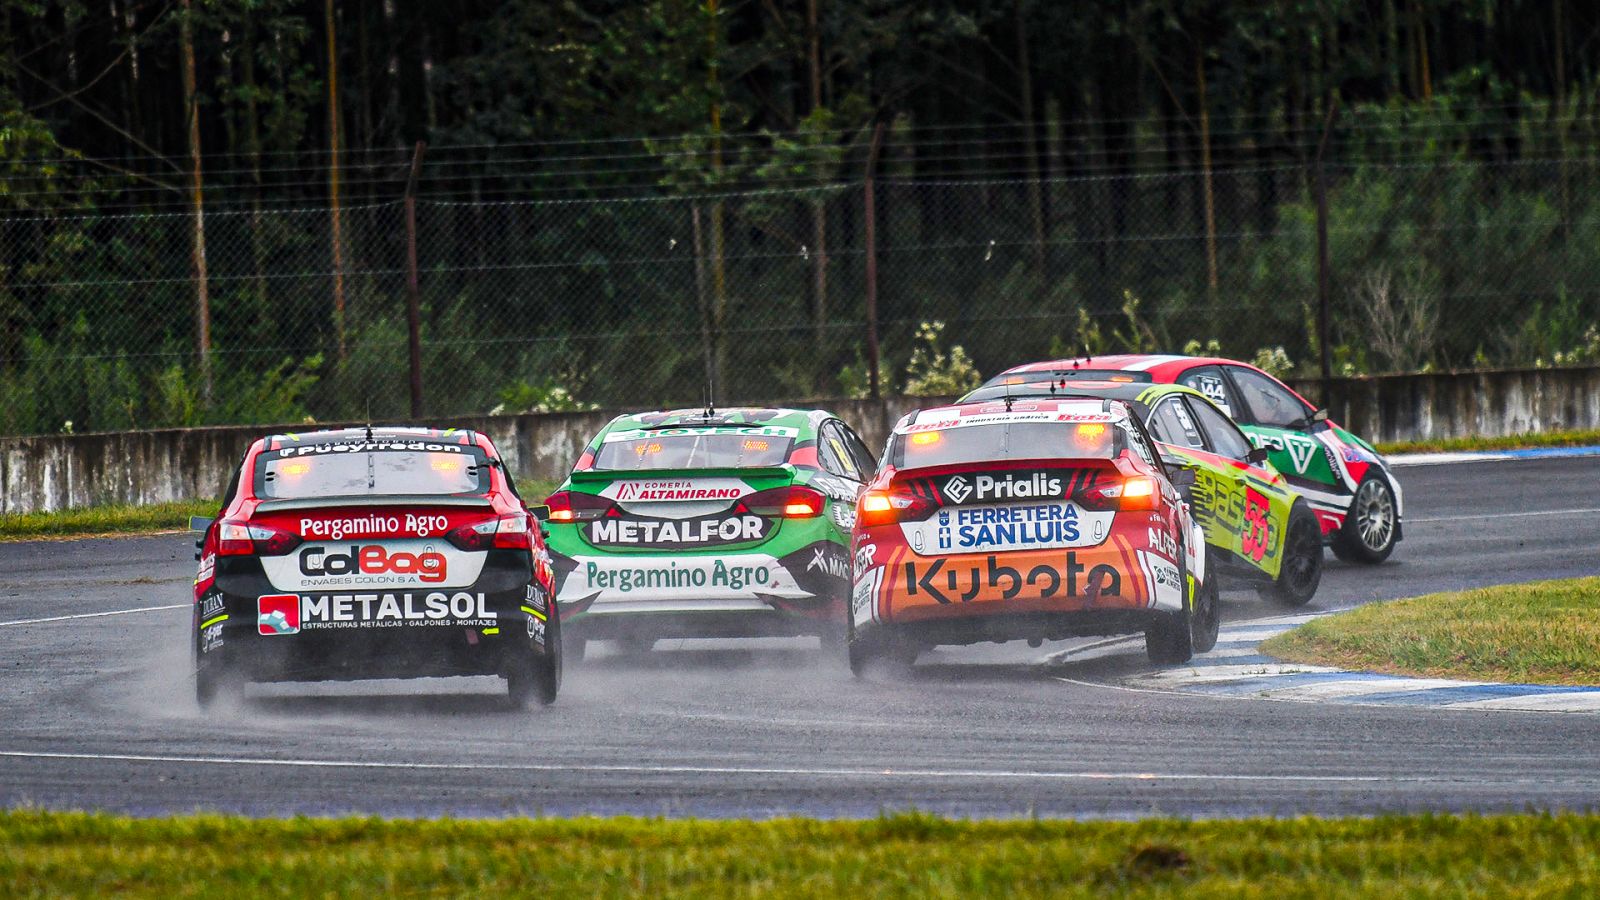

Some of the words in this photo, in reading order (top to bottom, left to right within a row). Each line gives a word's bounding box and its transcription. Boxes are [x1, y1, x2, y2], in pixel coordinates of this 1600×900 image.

[639, 488, 741, 499] ALTAMIRANO
[976, 473, 1062, 499] Prialis
[301, 514, 399, 540] Pergamino
[405, 514, 448, 537] Agro
[958, 504, 1079, 525] FERRETERA
[1242, 484, 1270, 562] 55
[592, 516, 763, 543] METALFOR
[958, 523, 1016, 547] SAN
[1020, 520, 1080, 543] LUIS
[299, 545, 448, 583] ColBag
[587, 561, 706, 592] Pergamino
[712, 560, 769, 590] Agro
[905, 551, 1121, 604] Kubota
[301, 577, 352, 587] ENVASES
[354, 577, 395, 585] COLON
[302, 592, 497, 622] METALSOL
[302, 621, 358, 629] ESTRUCTURAS
[409, 619, 451, 627] GALPONES
[456, 619, 498, 627] MONTAJES
